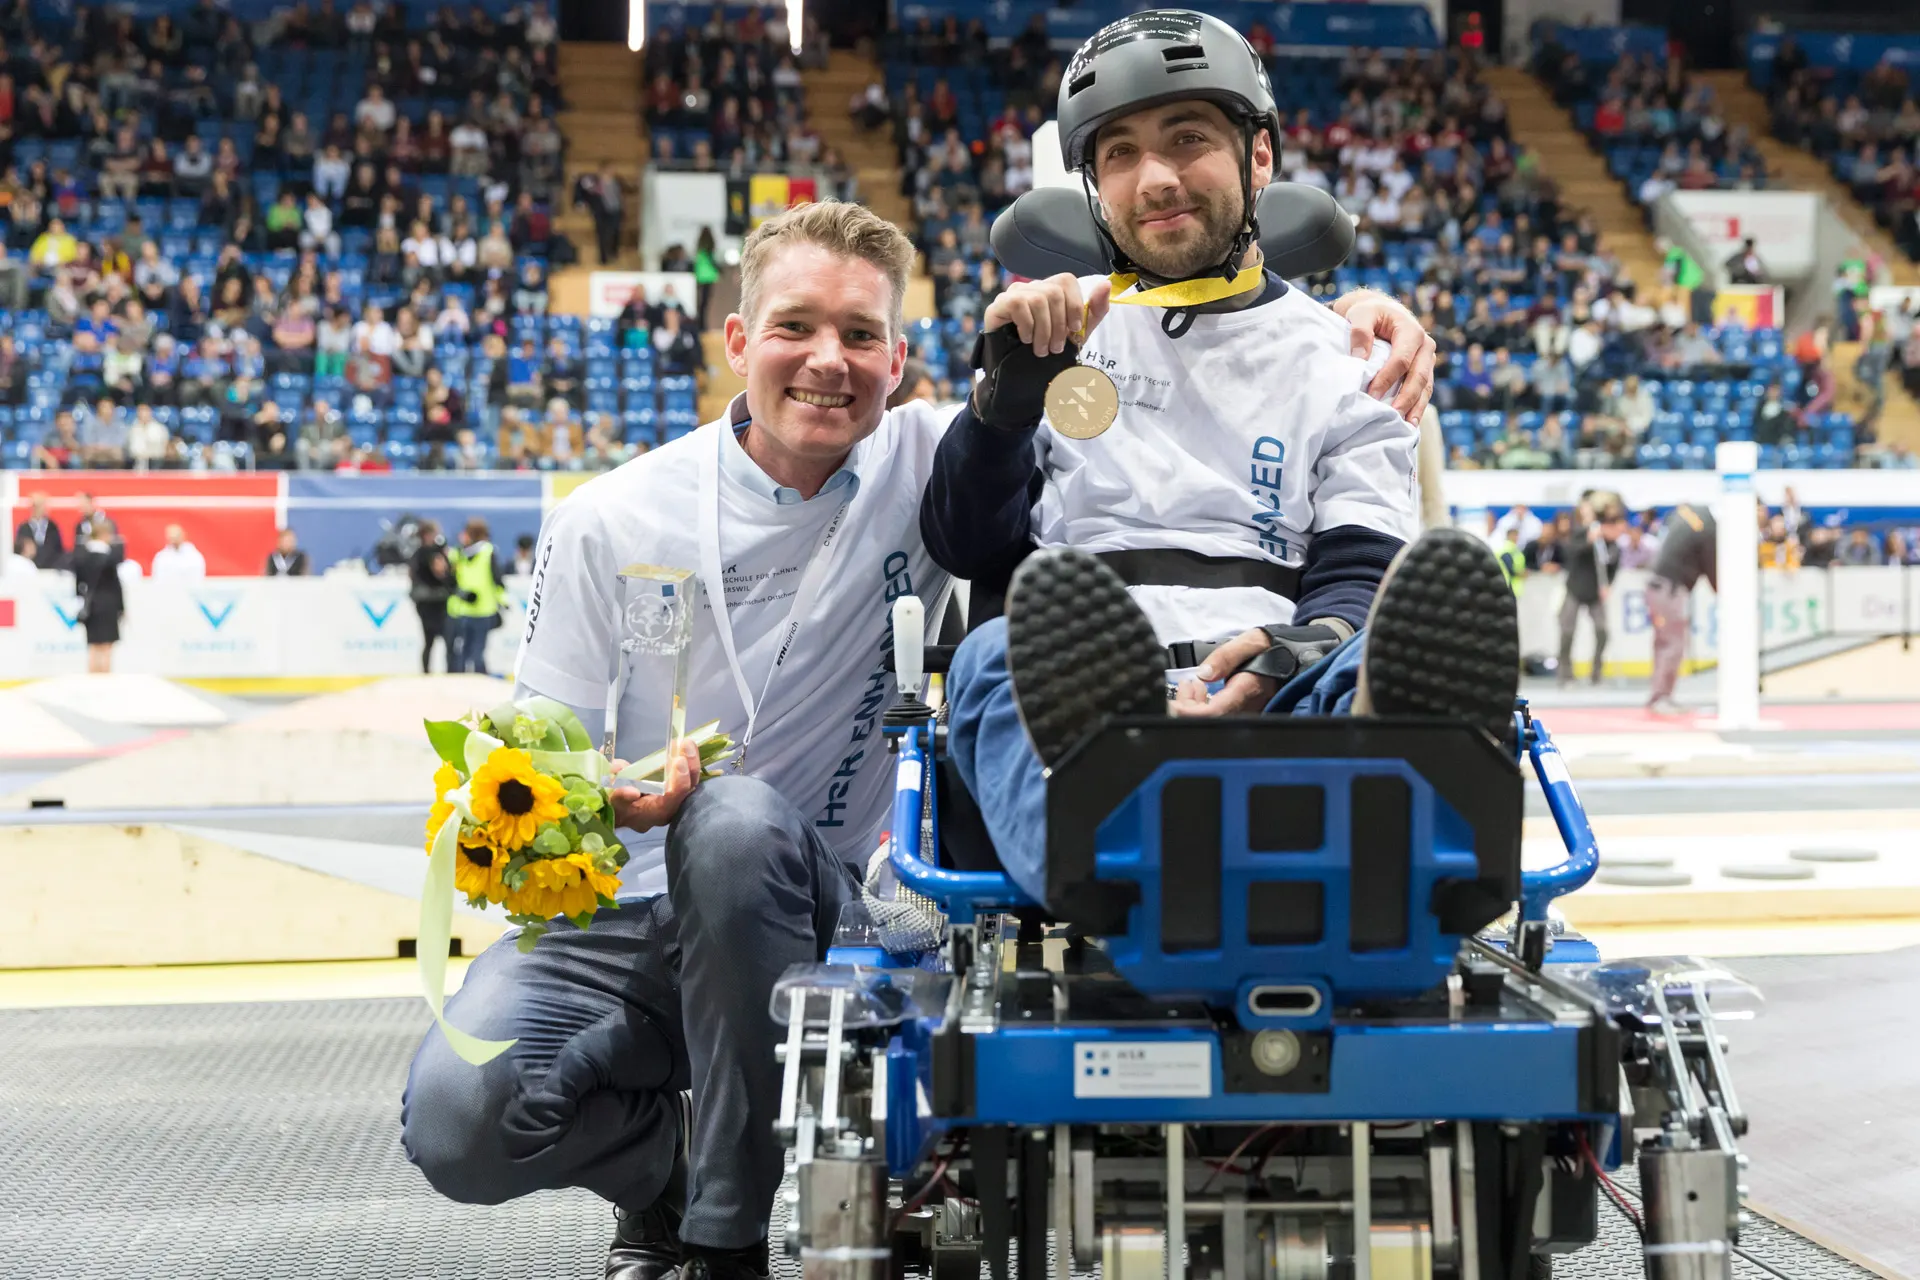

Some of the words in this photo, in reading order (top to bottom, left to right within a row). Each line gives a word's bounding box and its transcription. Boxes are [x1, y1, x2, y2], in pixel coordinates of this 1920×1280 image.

[1085, 350, 1117, 370] HSR
[755, 573, 770, 581] FÜR
[815, 749, 864, 828] HSR
